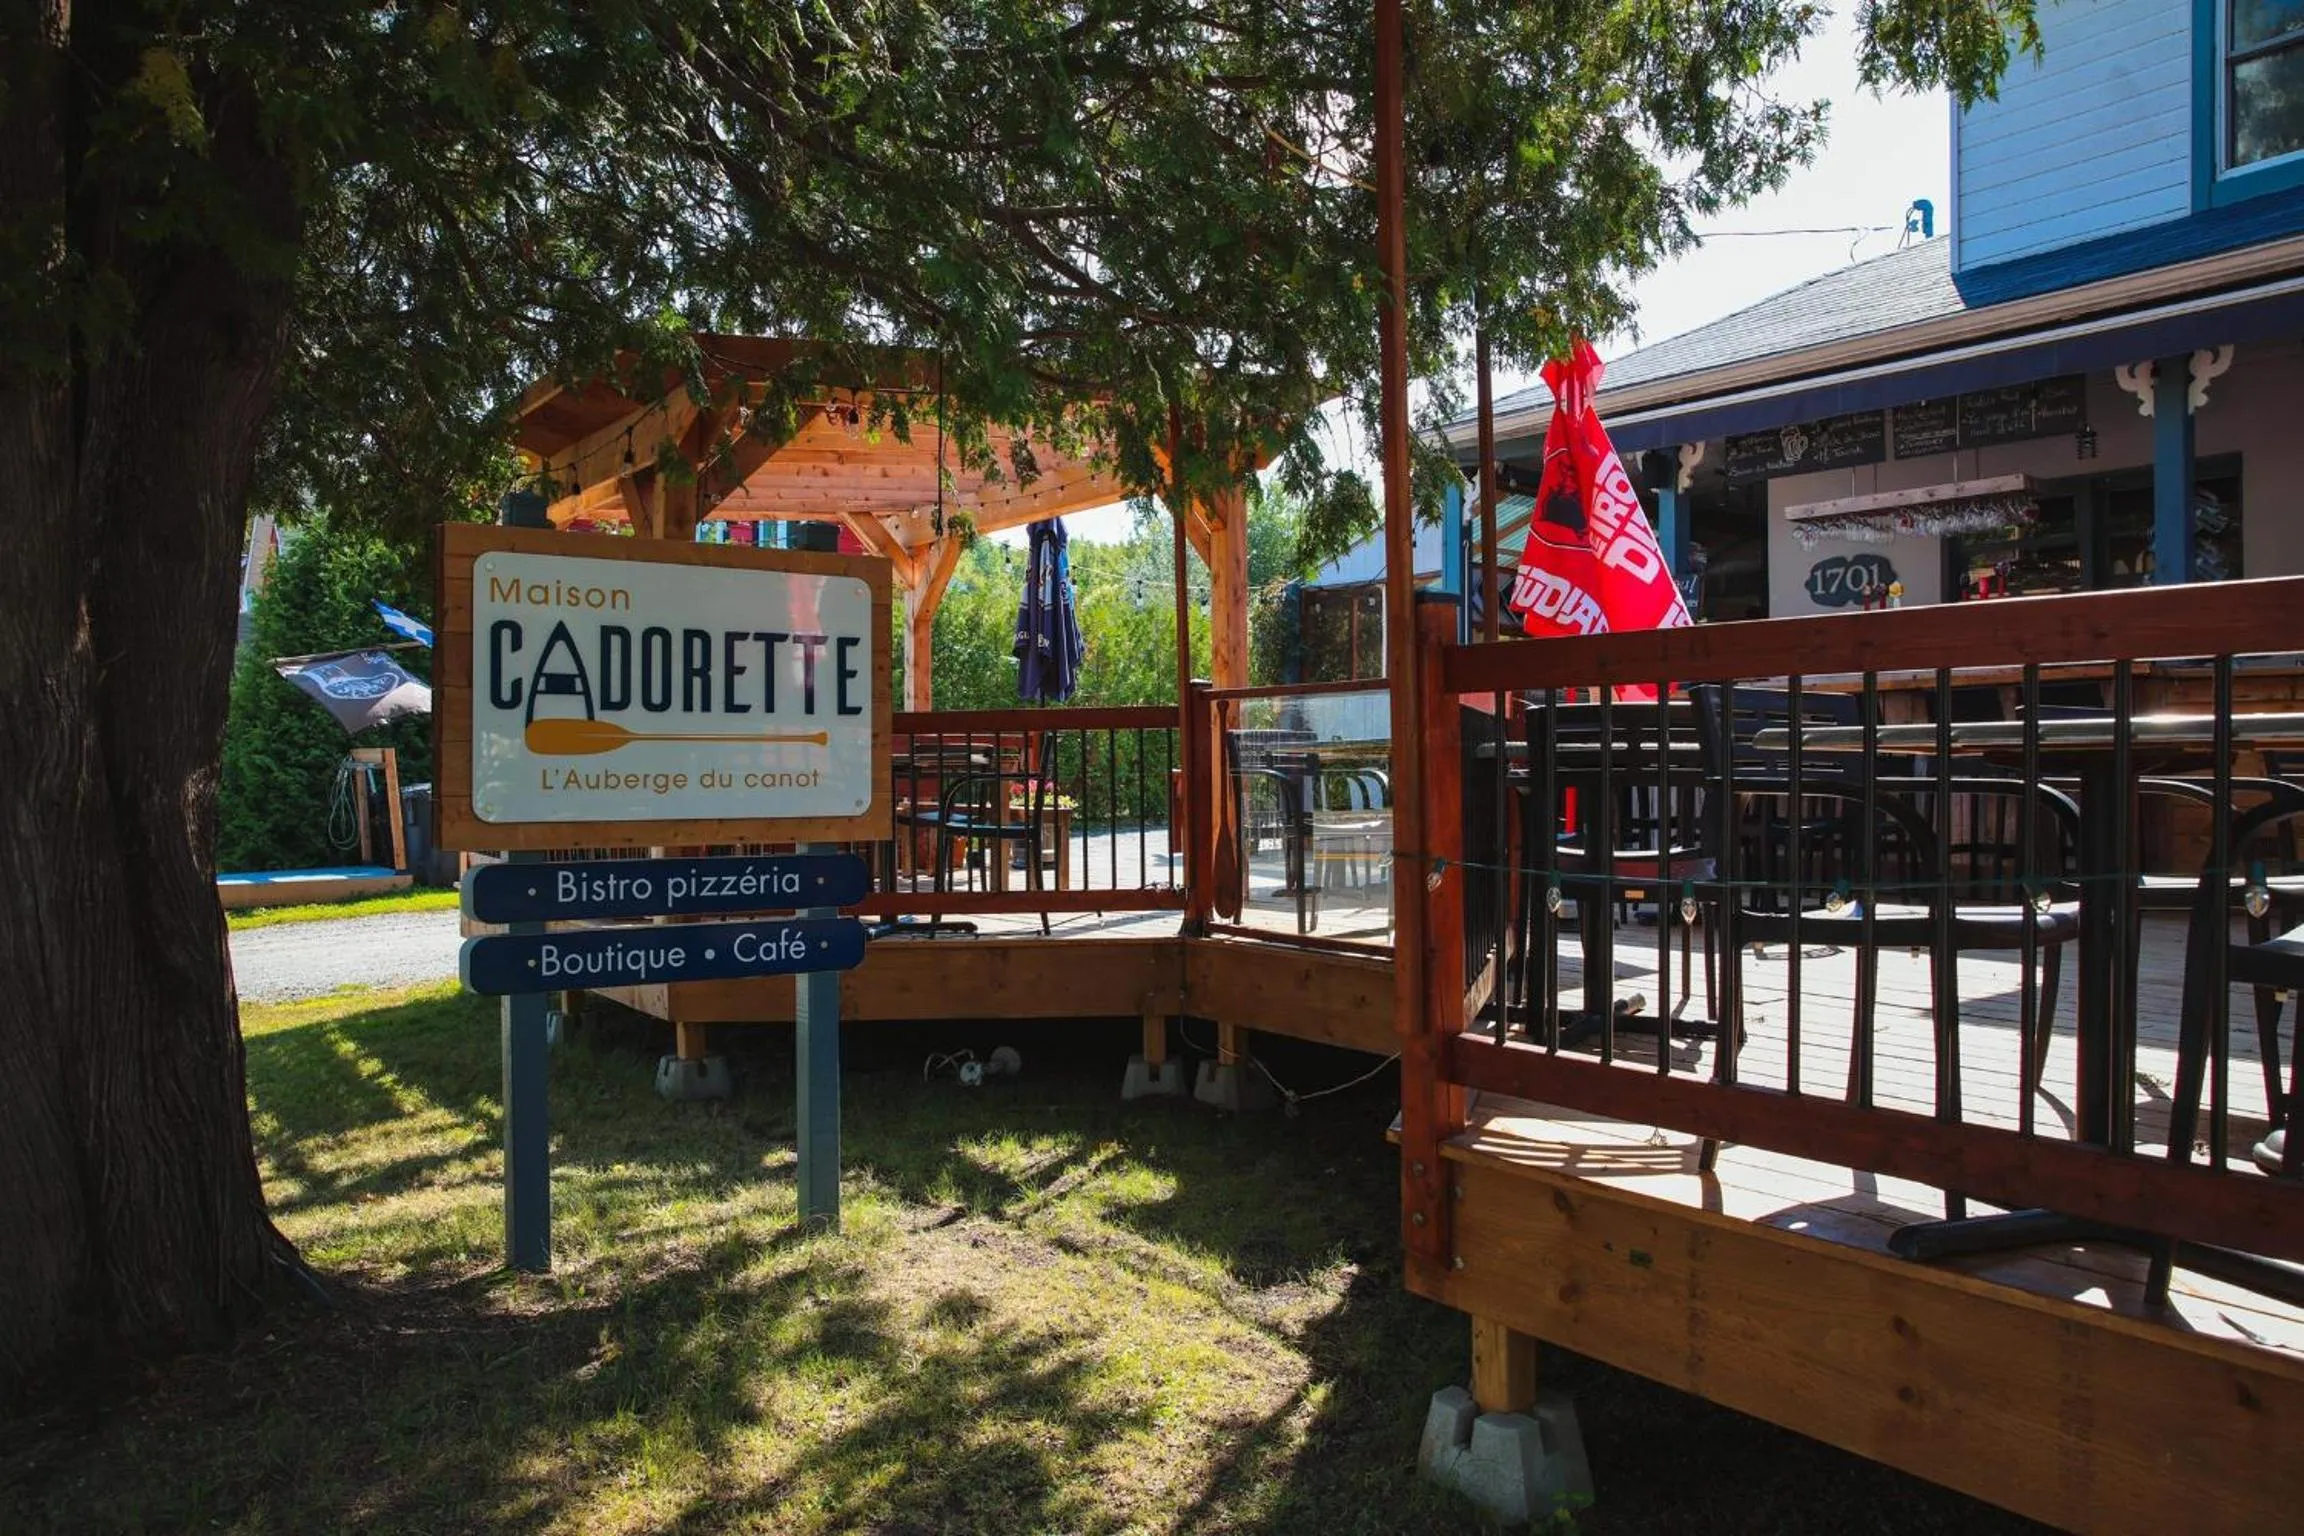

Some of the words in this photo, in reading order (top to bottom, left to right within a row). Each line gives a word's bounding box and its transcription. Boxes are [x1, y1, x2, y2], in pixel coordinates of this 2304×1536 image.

[489, 576, 631, 611] Maison
[1813, 563, 1880, 594] 1701
[490, 619, 862, 727] CADORETTE
[541, 768, 689, 794] L'Auberge
[699, 769, 732, 789] du
[744, 769, 820, 789] canot
[557, 871, 652, 902] Bistro
[667, 866, 800, 908] pizzéria
[541, 943, 687, 979] Boutique
[733, 928, 806, 962] Café
